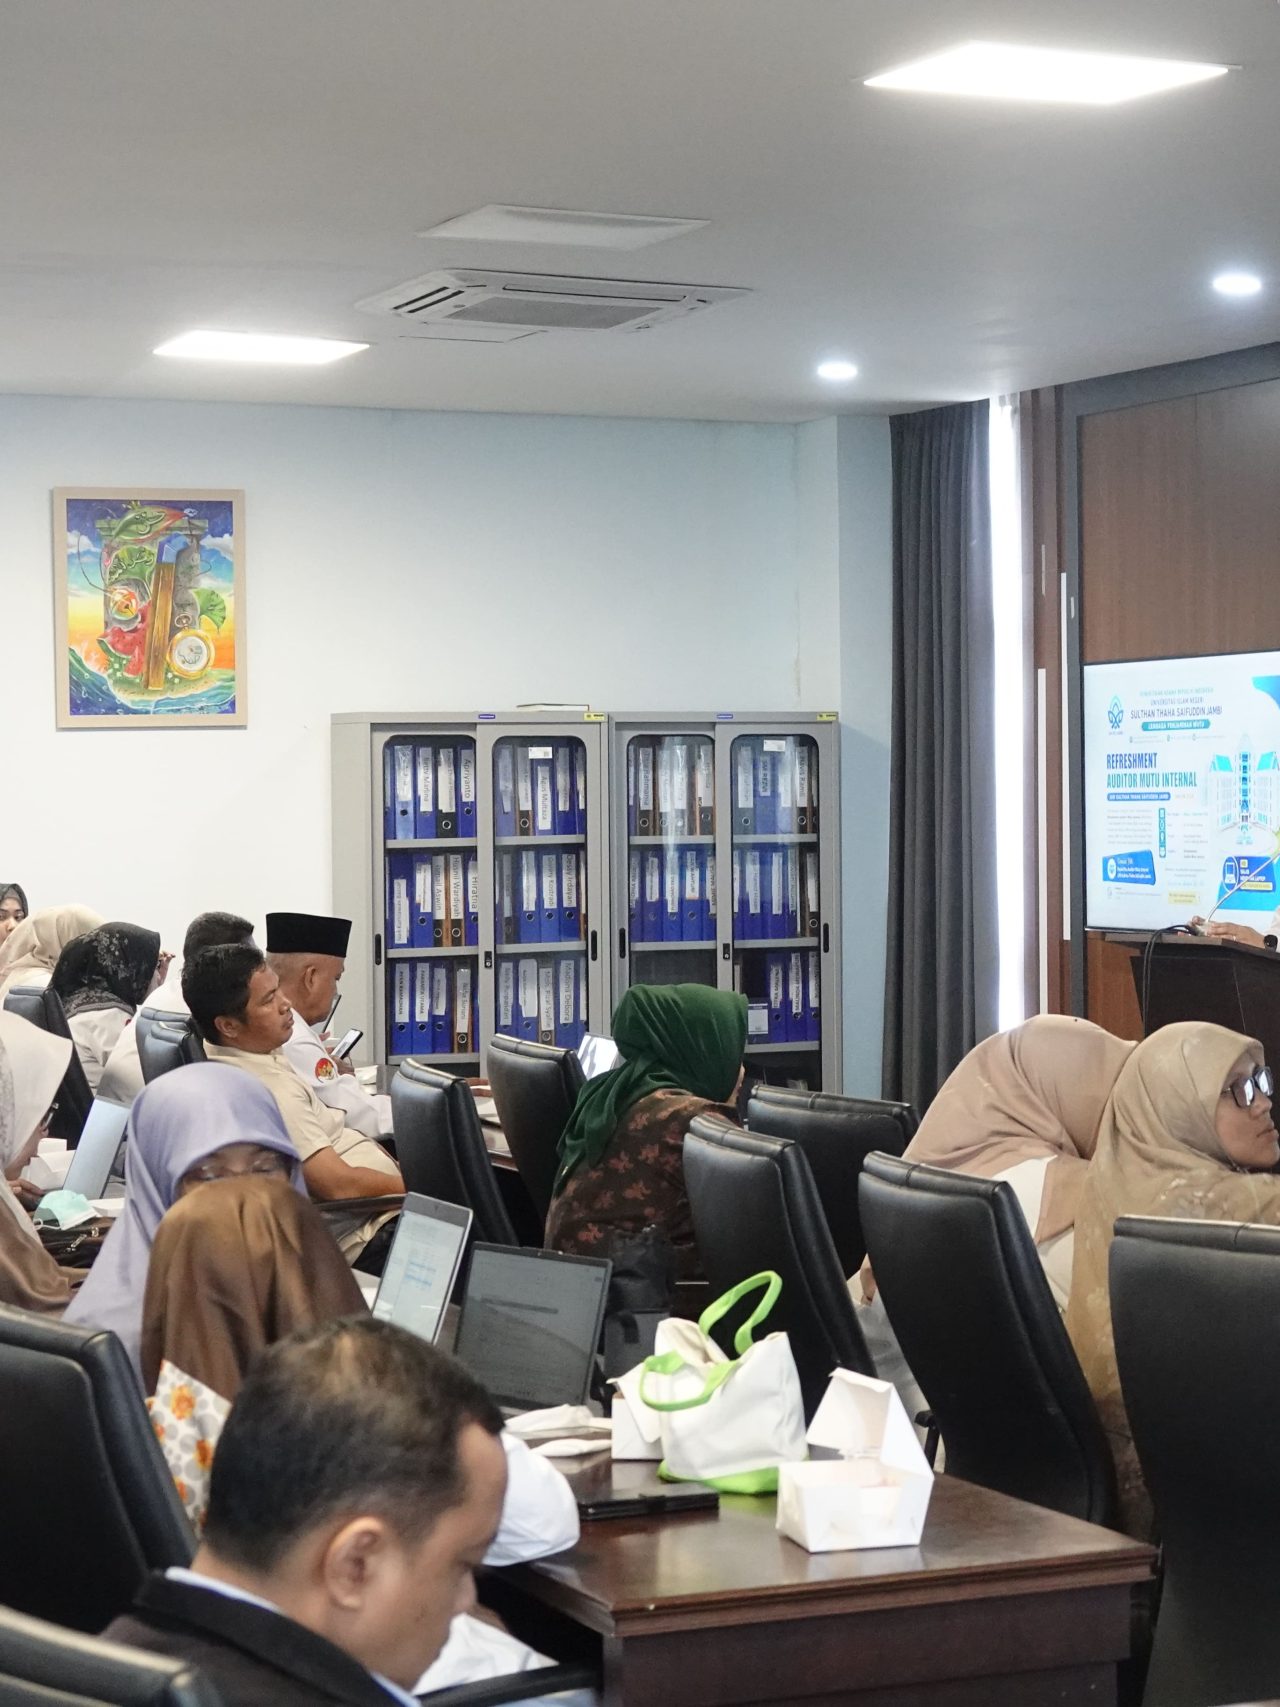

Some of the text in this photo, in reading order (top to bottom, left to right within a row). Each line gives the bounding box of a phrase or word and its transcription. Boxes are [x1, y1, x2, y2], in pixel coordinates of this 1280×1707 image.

[1131, 705, 1222, 719] SULTHAN THAHA SAIFUDDIN JAMBI
[1107, 753, 1157, 769] REFRESHMENT
[463, 759, 472, 799] Apriyanto
[1107, 772, 1197, 788] AUDITOR MUTU INTERNAL
[566, 877, 574, 906] Irdayani
